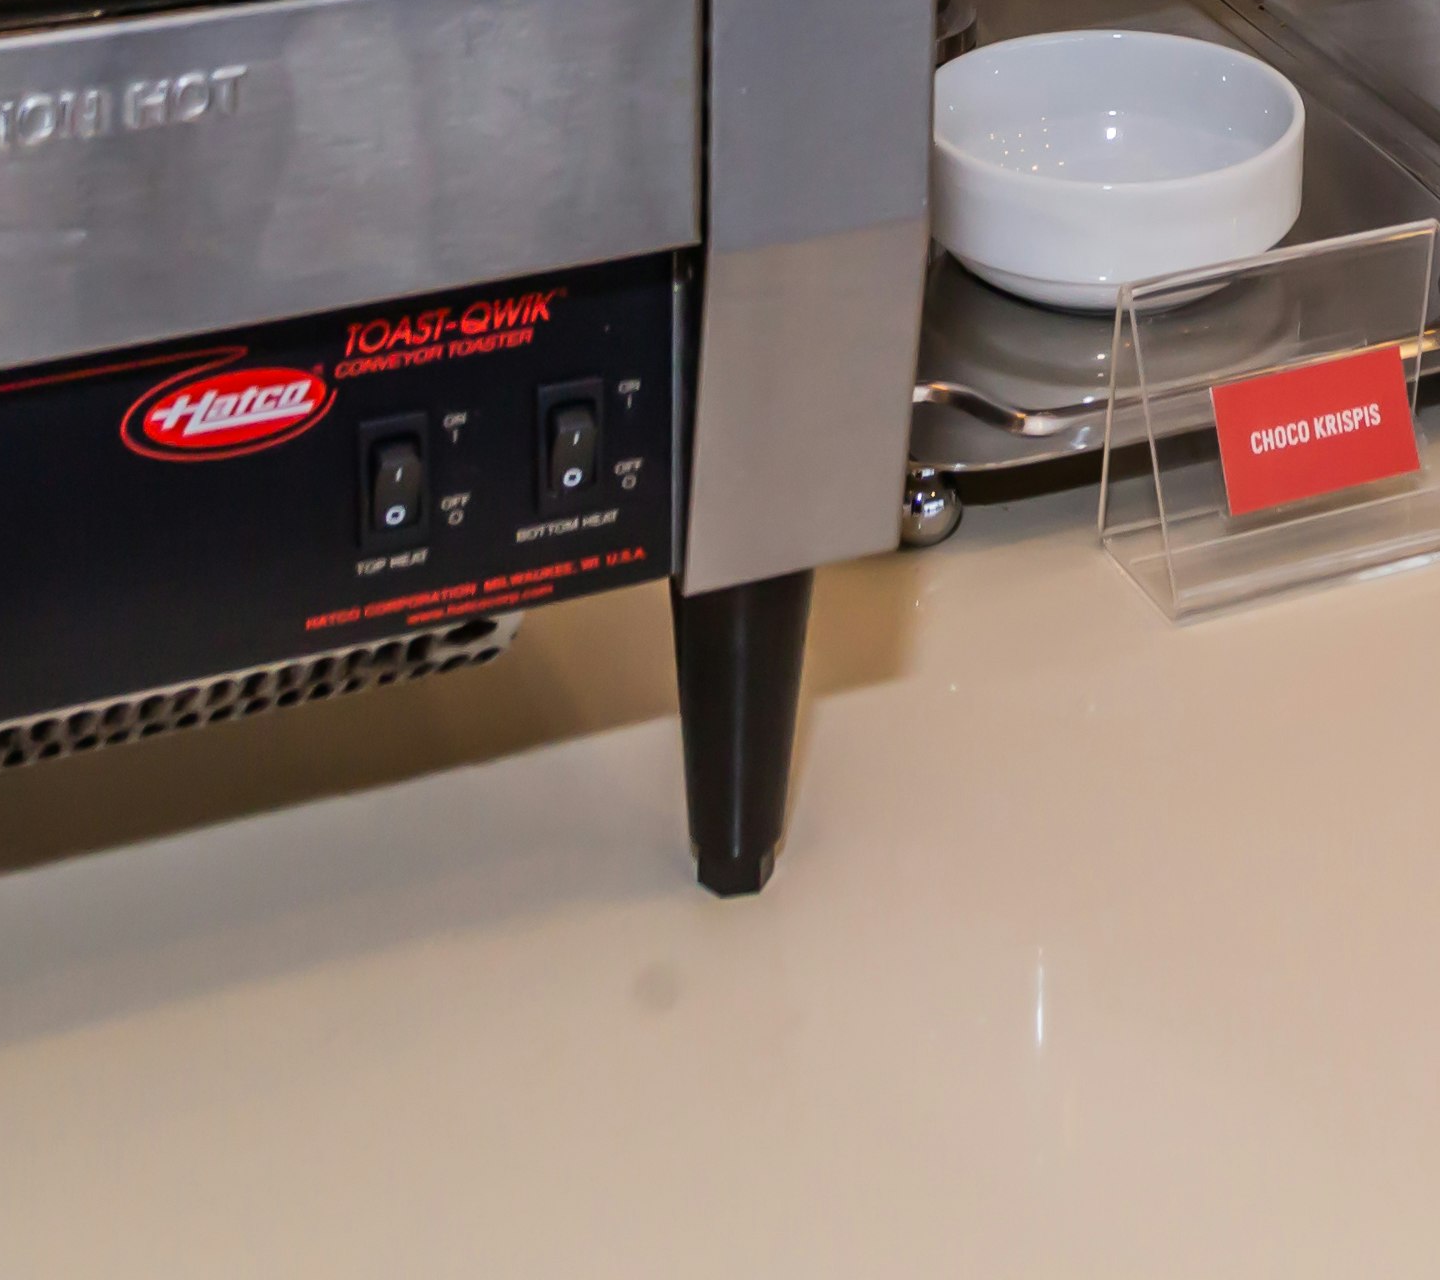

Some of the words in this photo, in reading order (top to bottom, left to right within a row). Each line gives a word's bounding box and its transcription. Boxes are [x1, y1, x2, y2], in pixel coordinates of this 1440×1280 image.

[124, 64, 249, 131] HOT
[345, 289, 556, 358] TOAST-QWIK
[334, 343, 444, 379] CONVEYOR
[448, 327, 534, 359] TOASTER
[151, 379, 314, 438] Hatco
[1250, 419, 1310, 454] CHOCO
[1314, 403, 1381, 439] KRISPIS
[516, 516, 580, 543] BOTTOM
